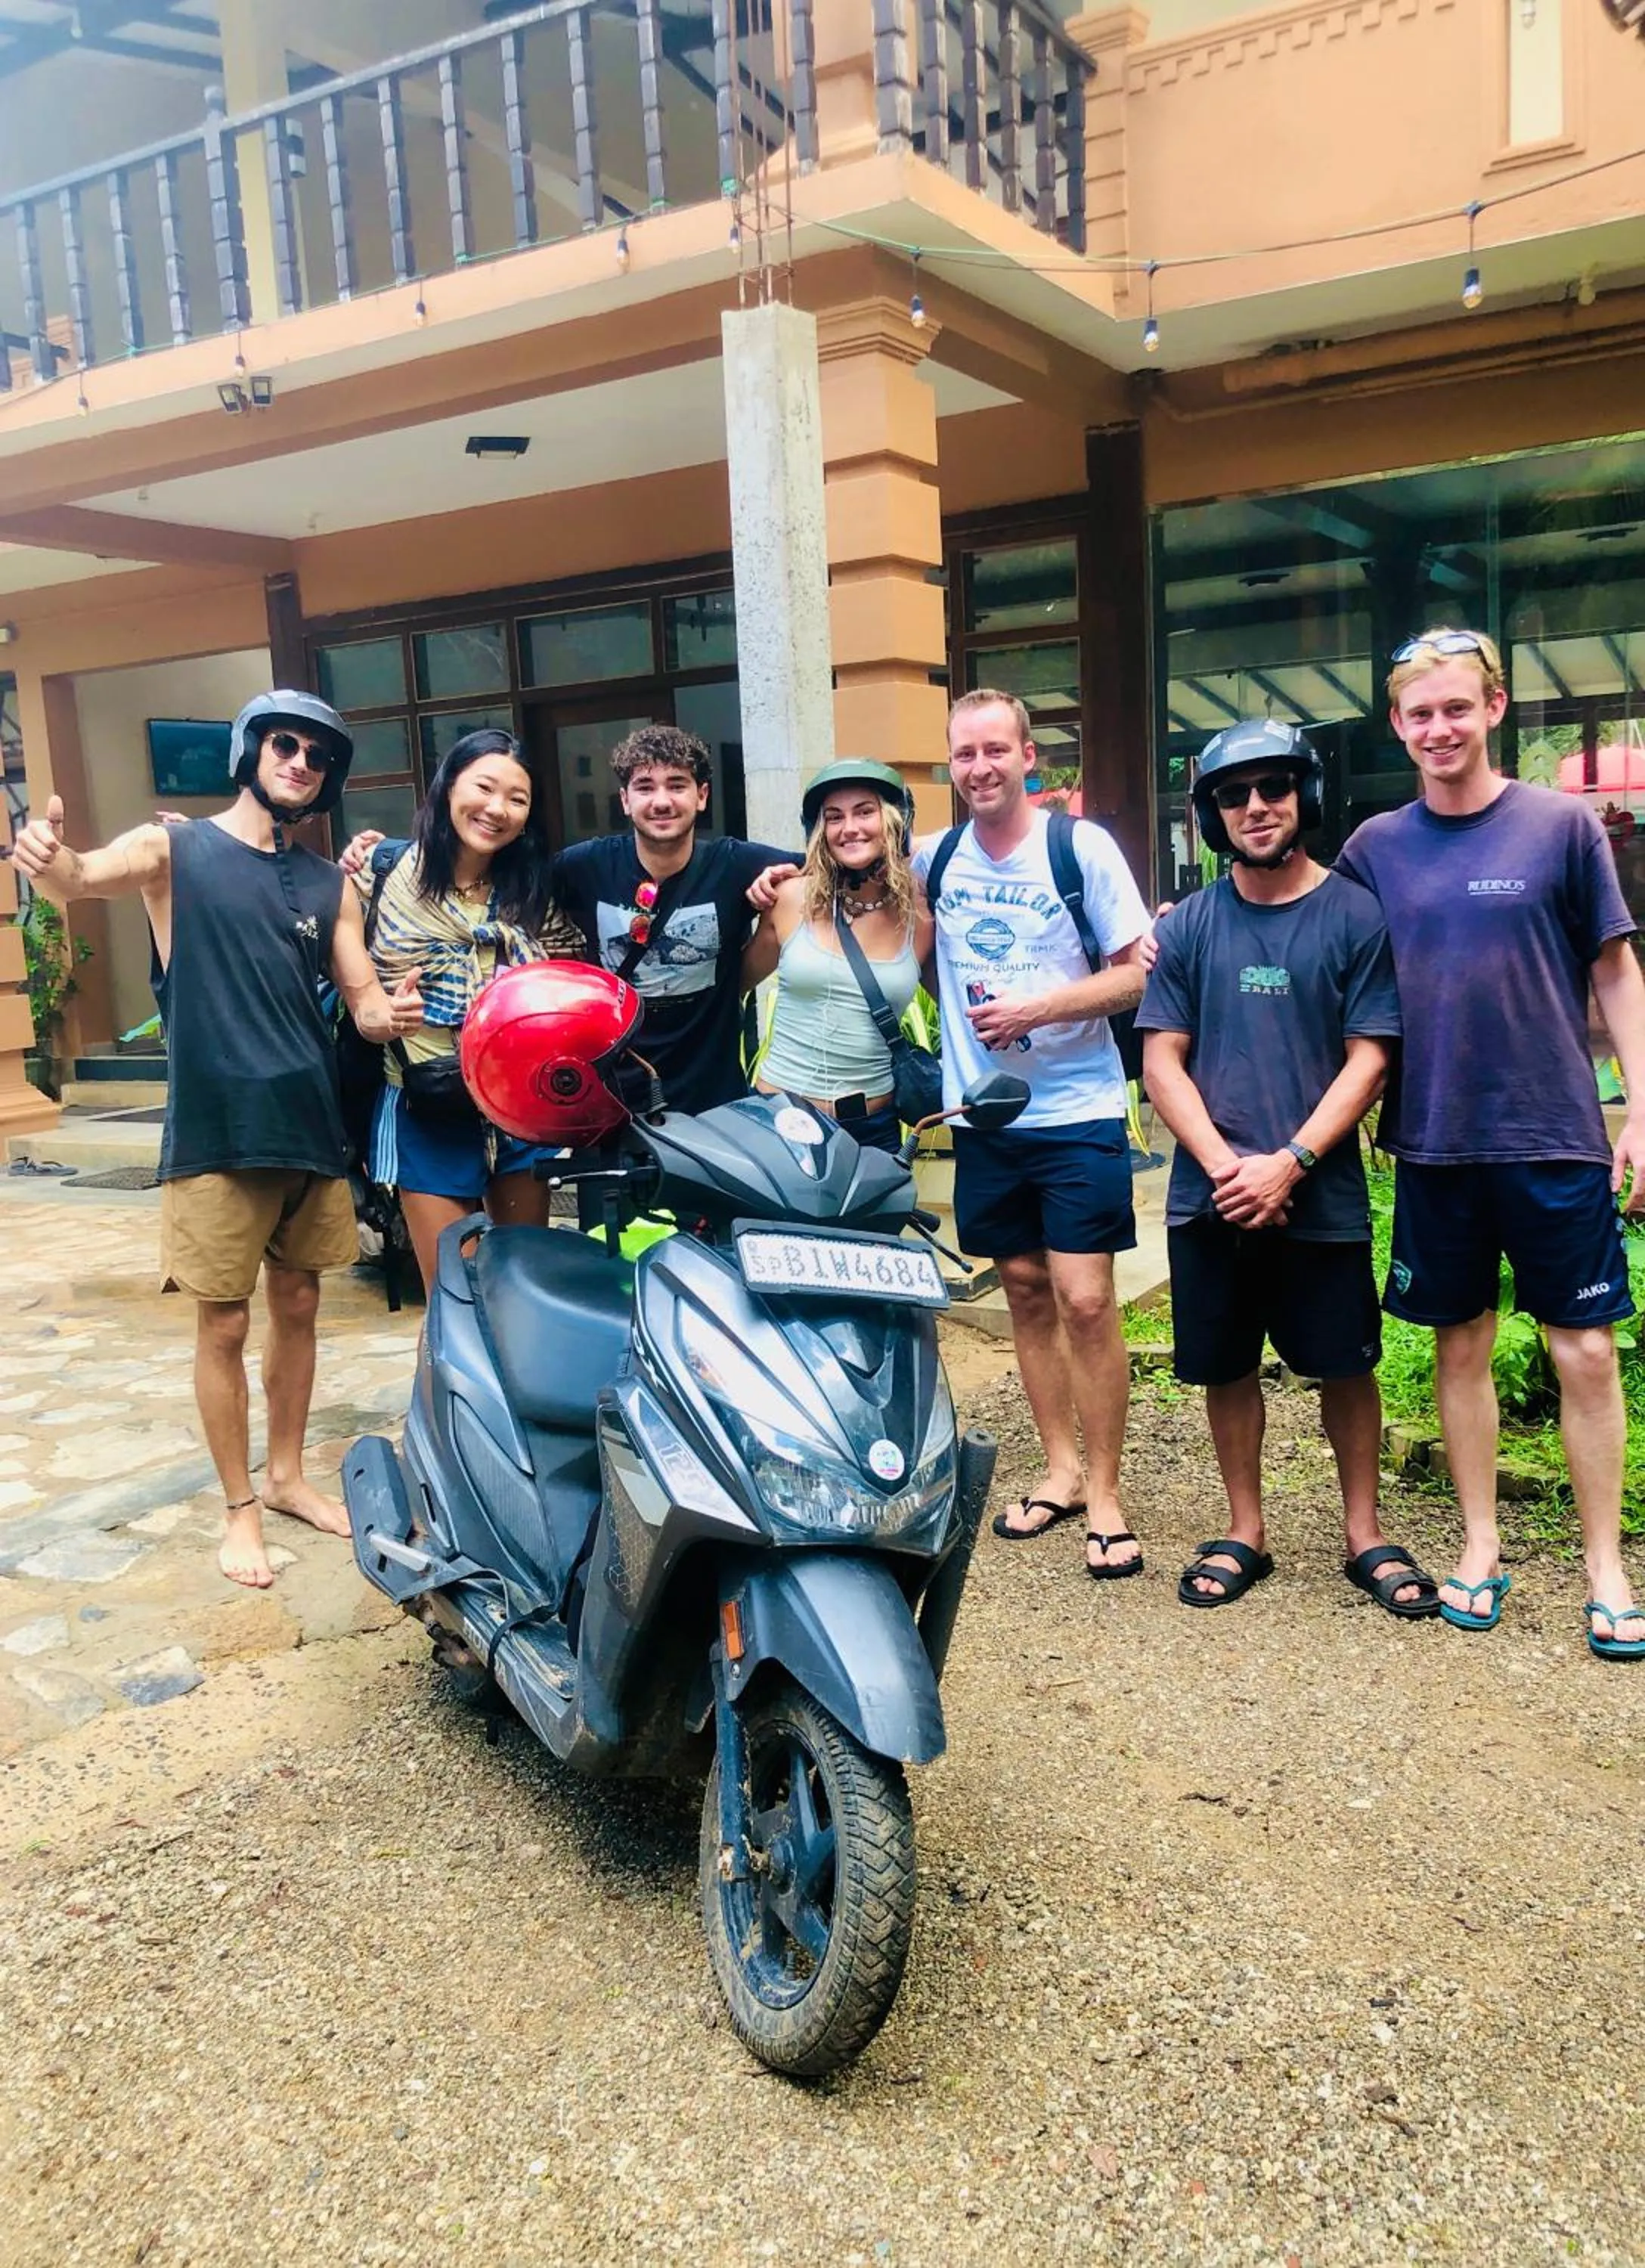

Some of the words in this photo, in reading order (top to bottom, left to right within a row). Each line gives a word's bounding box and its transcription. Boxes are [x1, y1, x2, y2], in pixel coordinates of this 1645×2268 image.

[982, 885, 1061, 920] TAILOR
[993, 961, 1040, 974] QUALITY
[1576, 1282, 1609, 1300] JAKO
